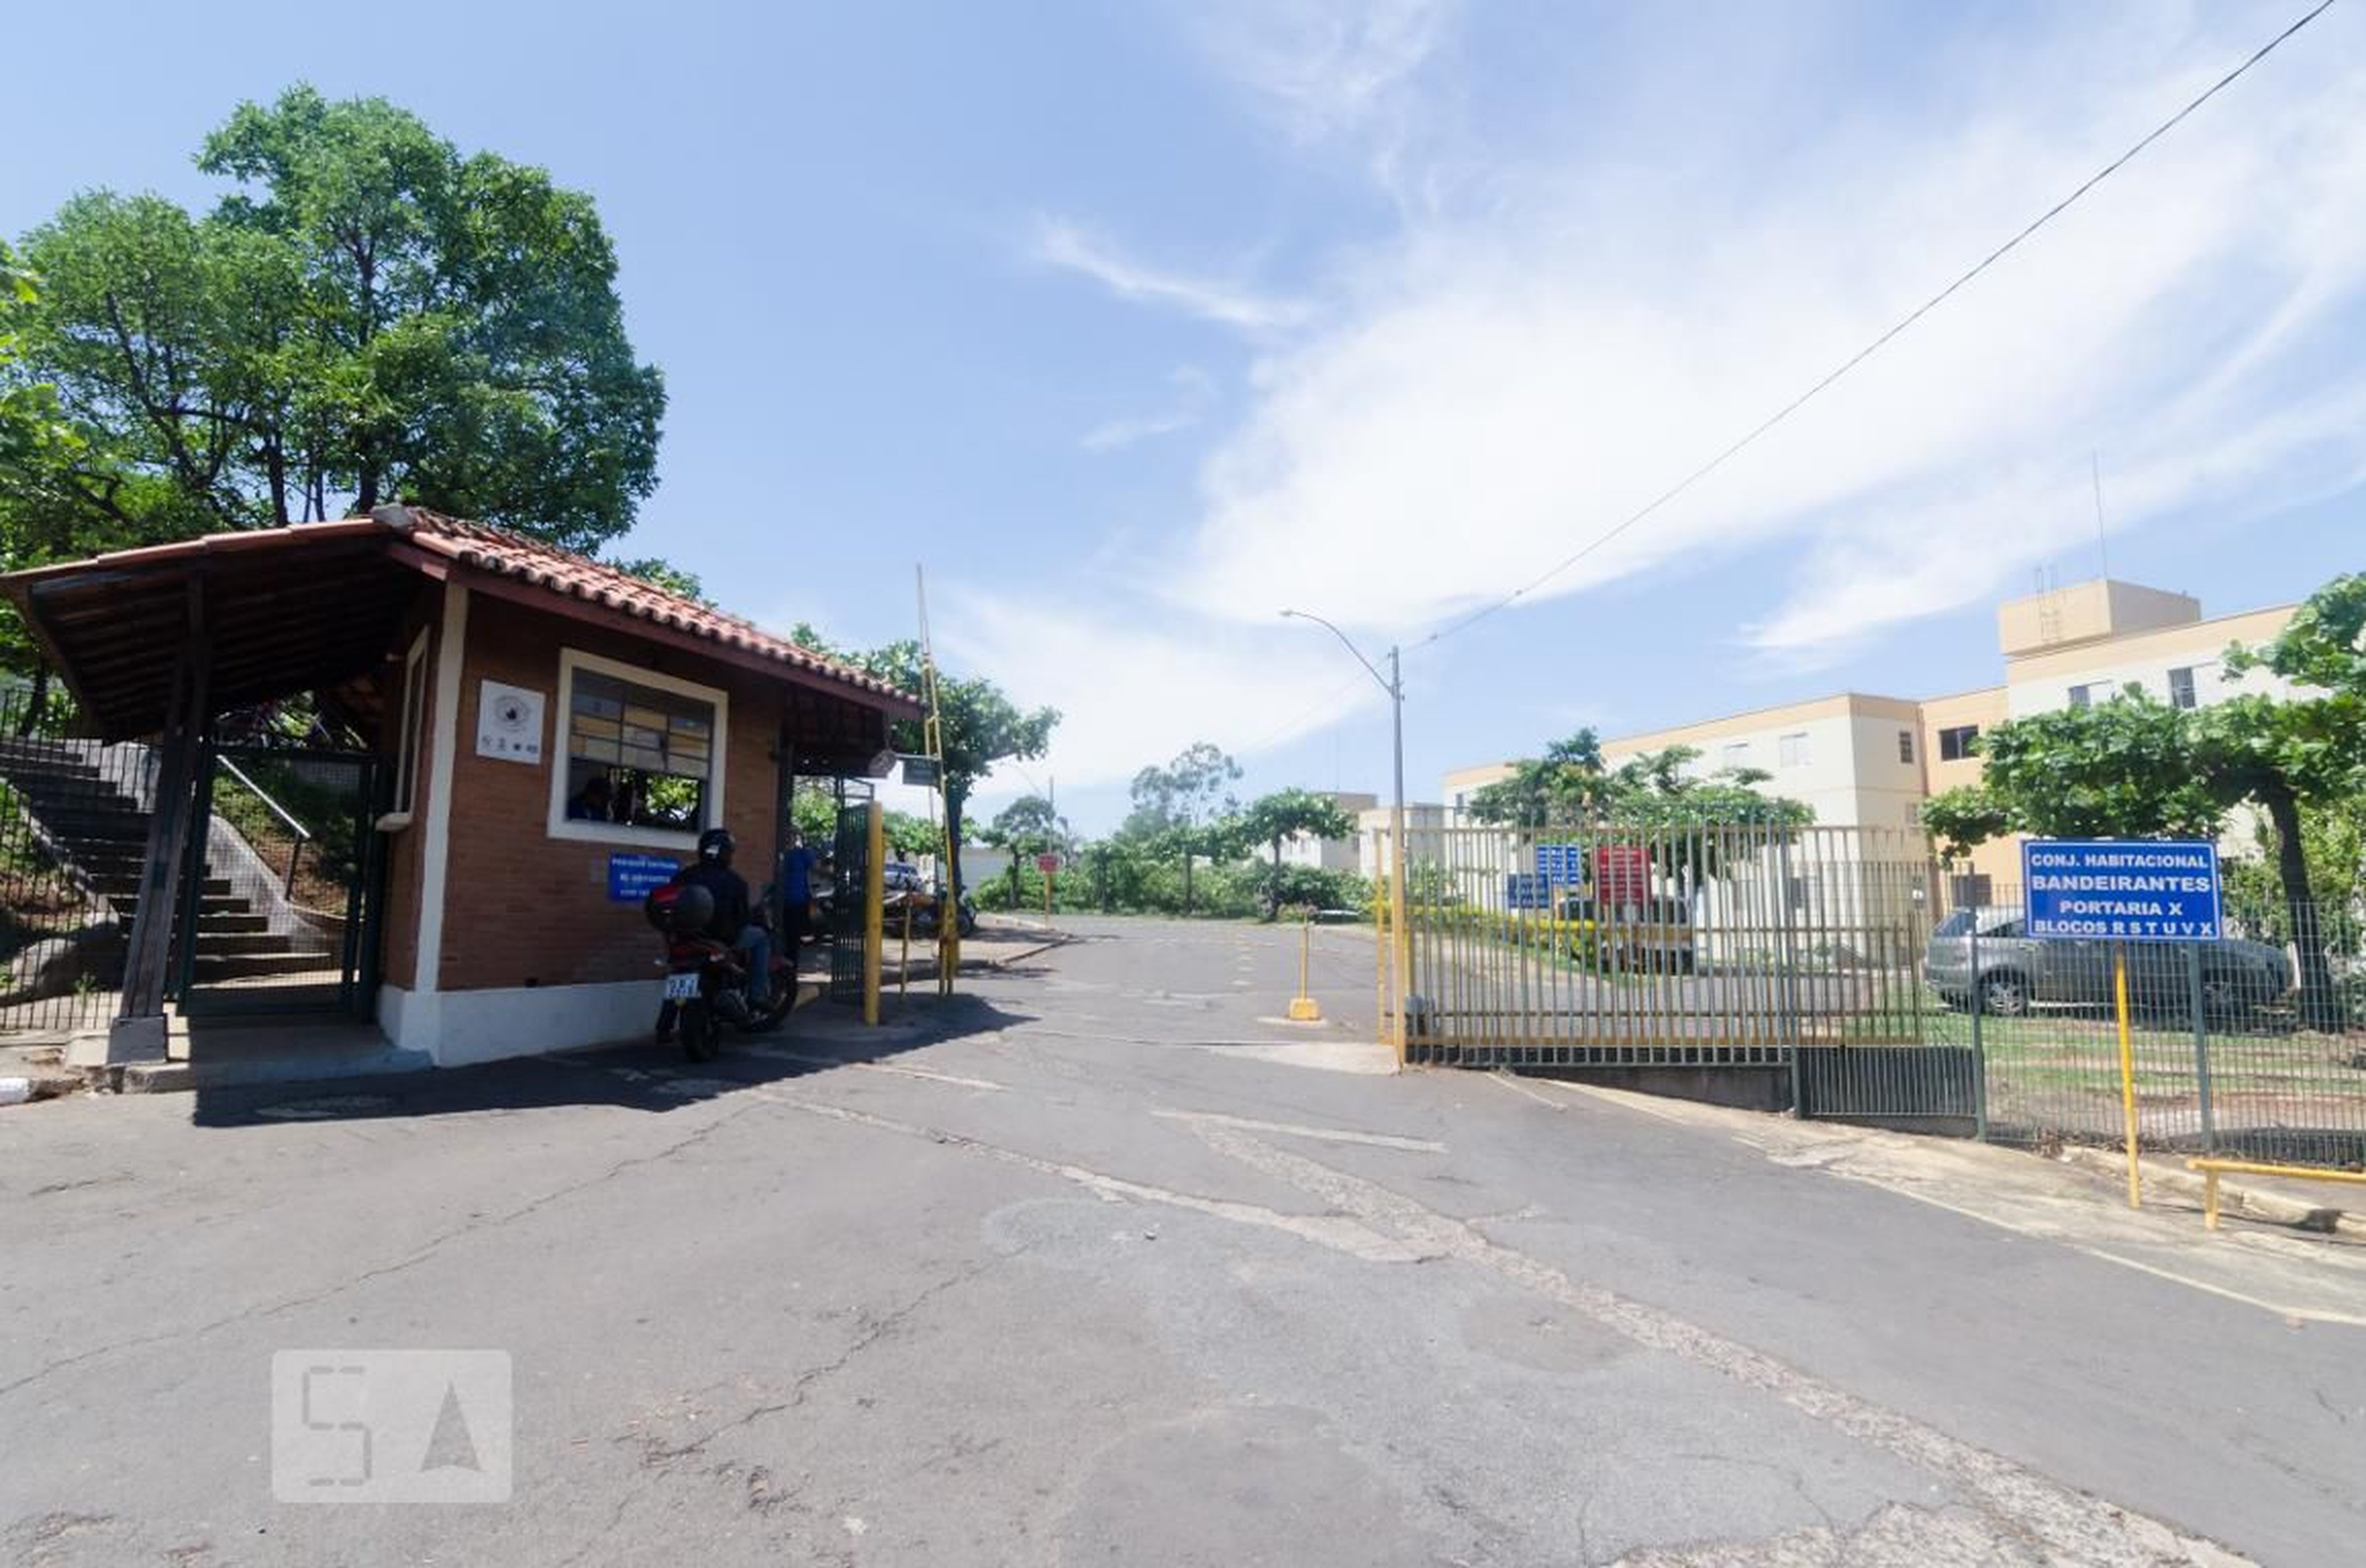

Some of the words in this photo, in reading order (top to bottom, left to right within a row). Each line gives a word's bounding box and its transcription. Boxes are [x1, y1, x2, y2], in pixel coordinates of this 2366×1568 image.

[2031, 854, 2081, 867] CONJ.
[2085, 855, 2208, 868] HABITACIONAL
[2033, 875, 2211, 892] BANDEIRANTES
[2060, 900, 2162, 916] PORTARIA
[2168, 902, 2183, 916] X
[2035, 920, 2107, 933] BLOCOS
[2113, 922, 2125, 933] R
[2130, 922, 2142, 934] S
[2146, 922, 2159, 934] T
[2163, 922, 2176, 935] U
[2181, 923, 2194, 935] V
[2200, 923, 2212, 935] X
